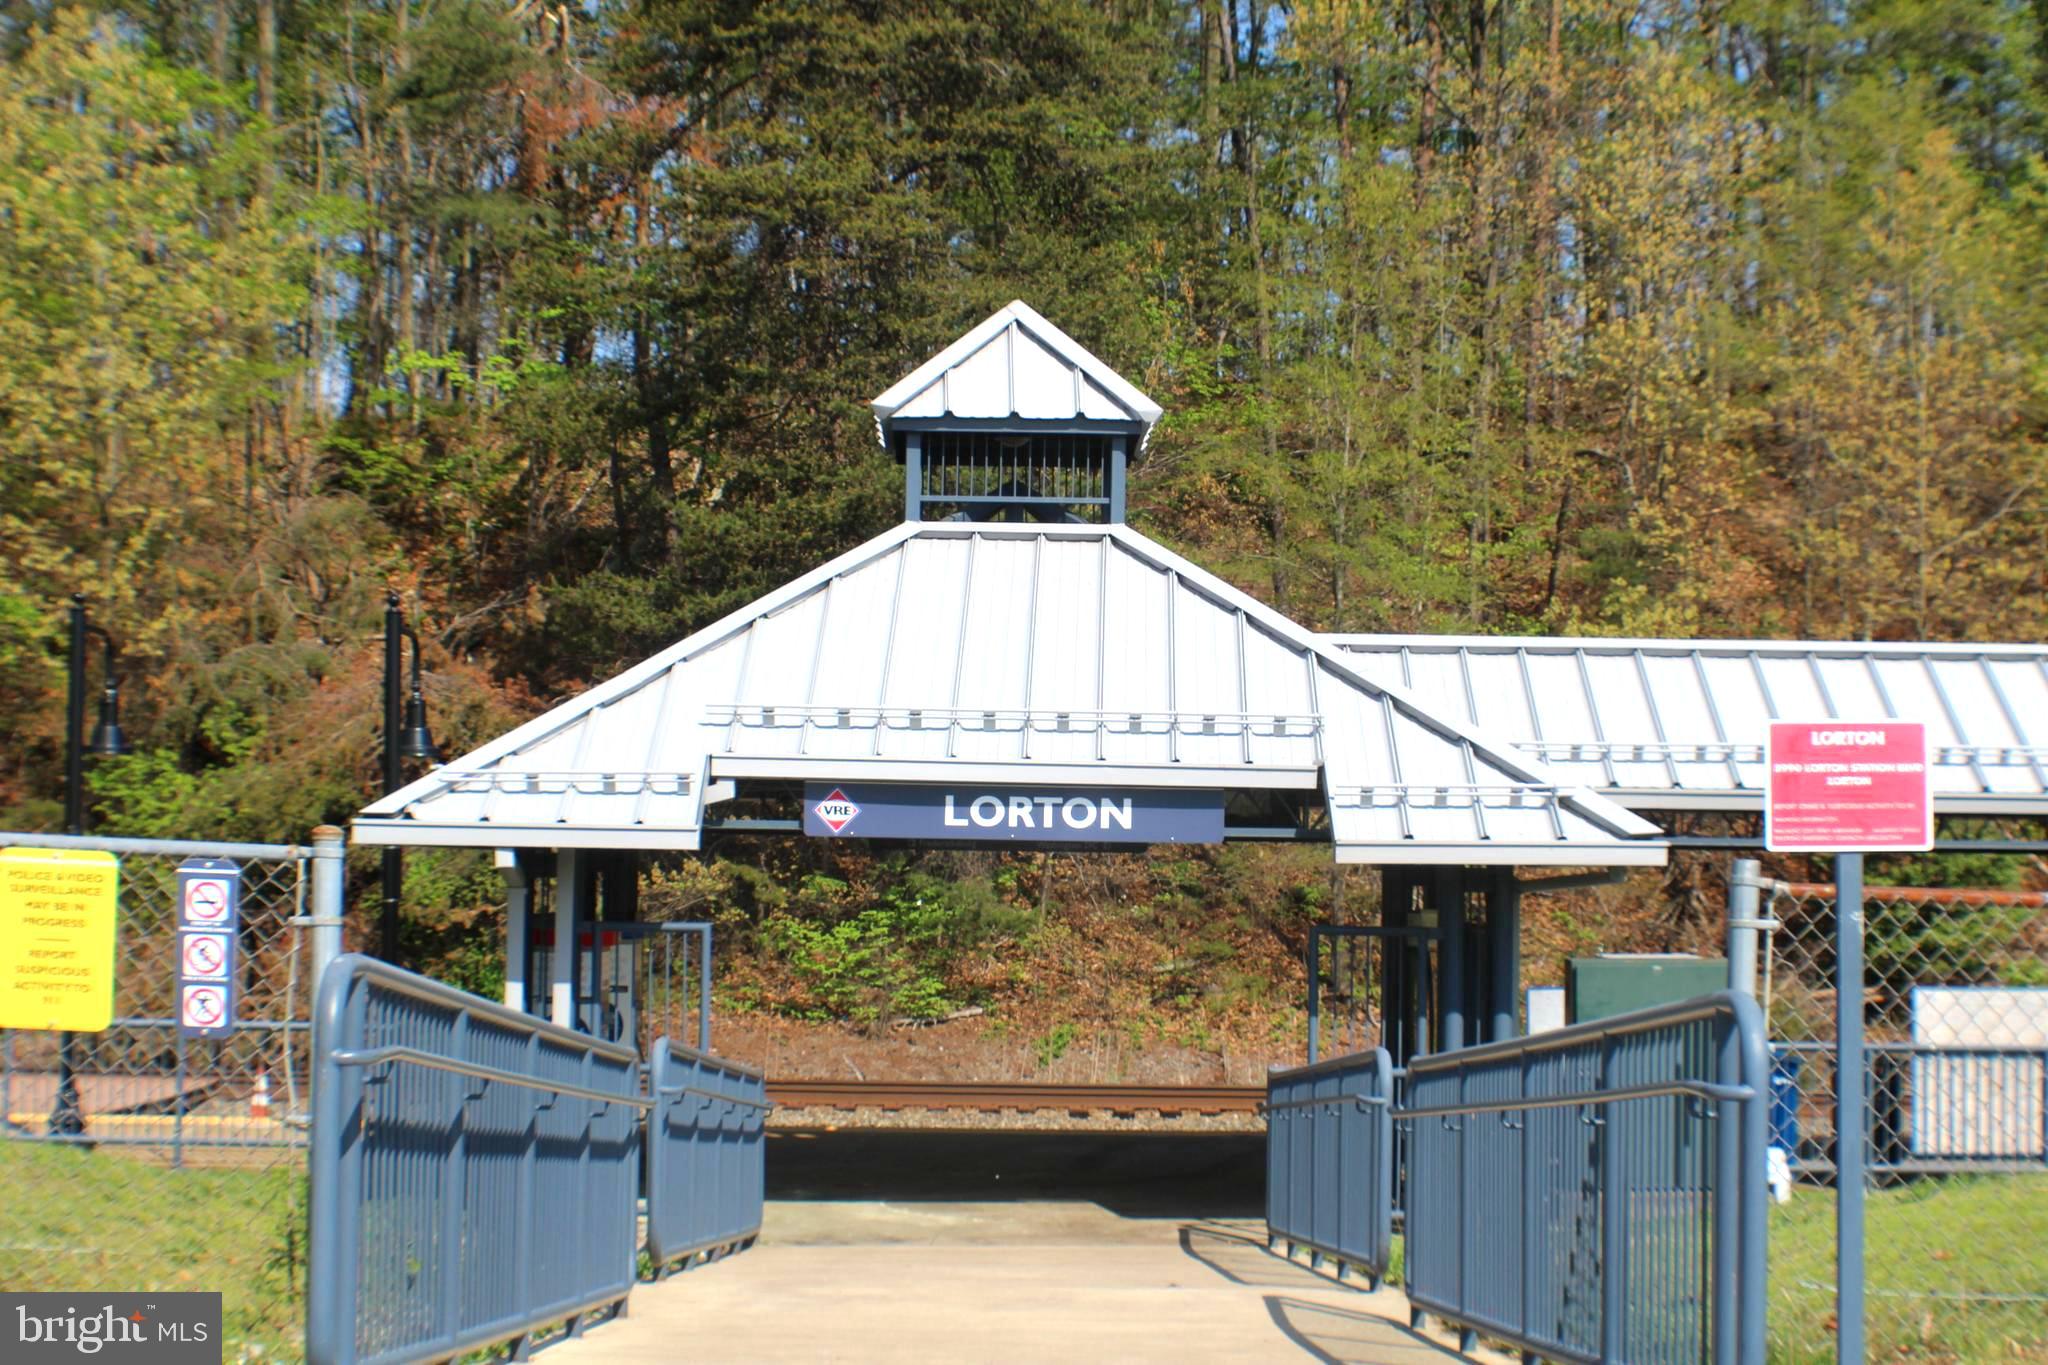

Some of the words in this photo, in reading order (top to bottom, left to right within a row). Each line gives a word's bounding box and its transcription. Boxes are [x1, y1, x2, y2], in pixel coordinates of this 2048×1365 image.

[1811, 731, 1886, 746] LORTON
[1804, 763, 1849, 773] LORTON
[824, 805, 851, 816] VRE
[944, 794, 1132, 830] LORTON
[8, 870, 53, 881] POLICE
[66, 872, 105, 884] VIDEO
[9, 883, 104, 896] SURVEILLANCE
[22, 916, 87, 929] PROGRESS
[28, 949, 77, 959] REPORT
[15, 964, 91, 977] SUSPICIOUS
